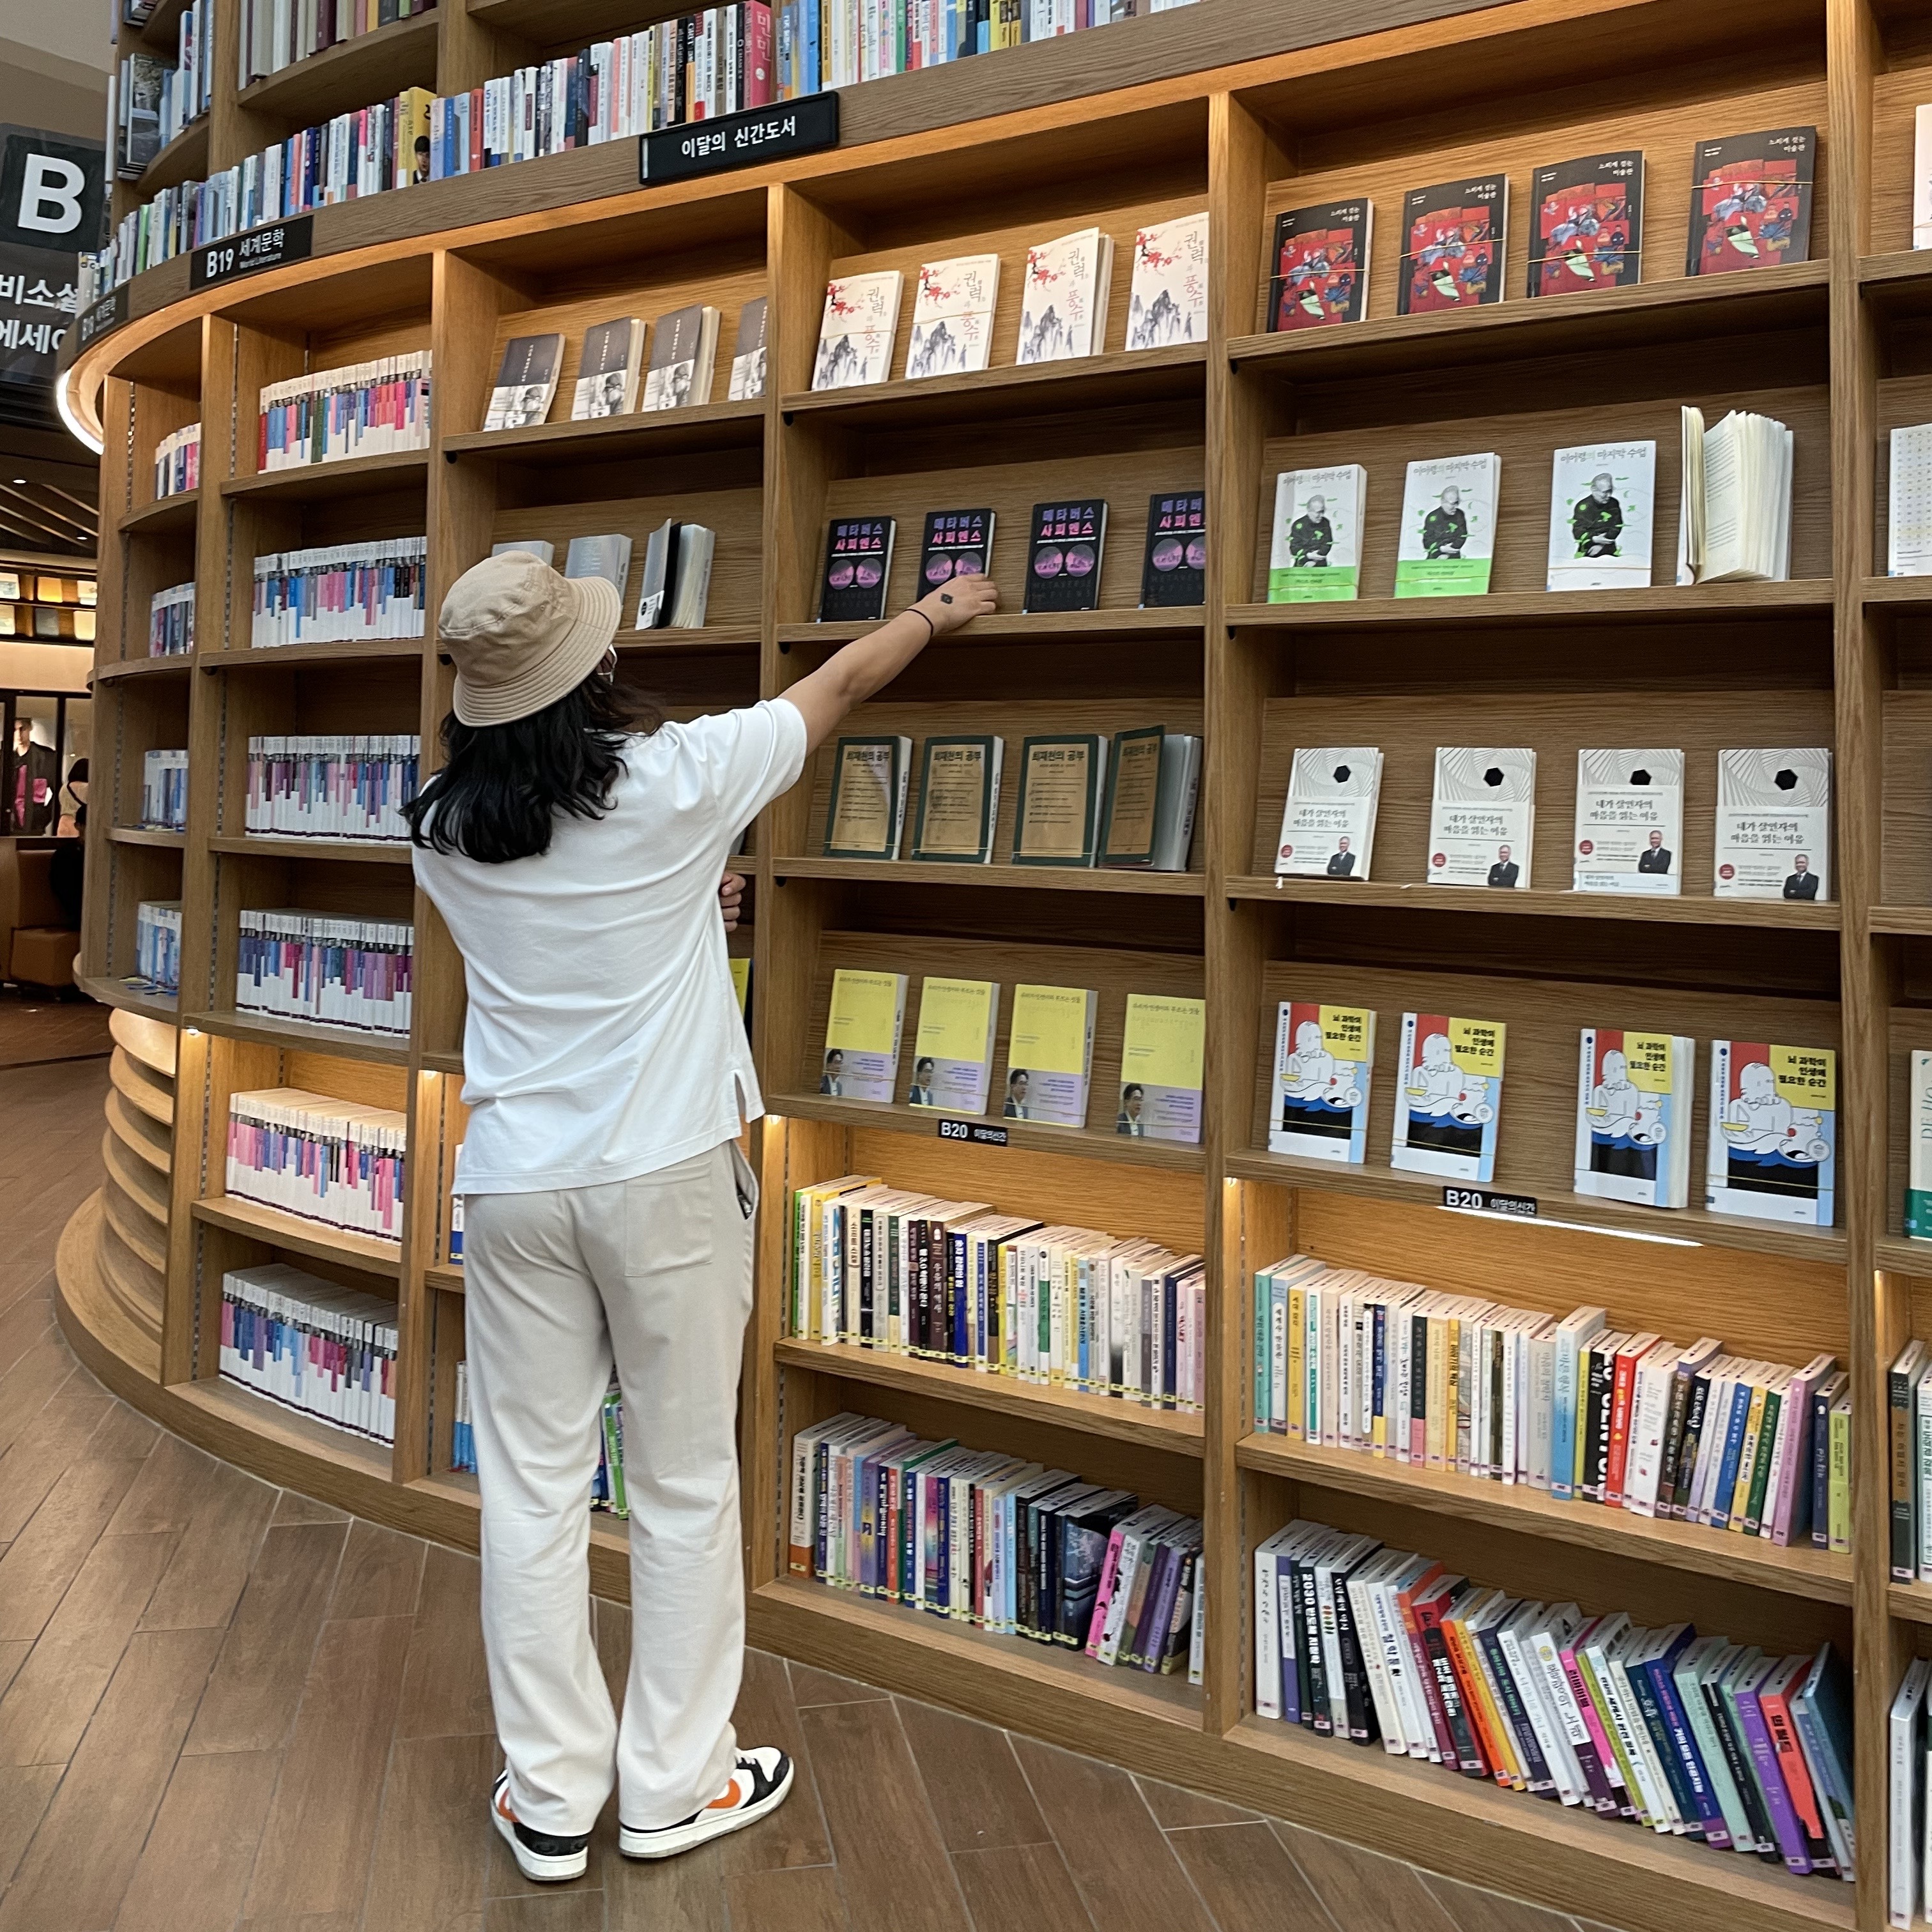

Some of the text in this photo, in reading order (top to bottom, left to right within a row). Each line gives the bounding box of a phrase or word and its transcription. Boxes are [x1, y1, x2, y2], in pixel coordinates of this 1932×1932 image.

[682, 116, 795, 158] 이달의 신간도서
[17, 153, 86, 234] B
[238, 228, 285, 257] 세계문학
[206, 248, 234, 278] B19
[1598, 448, 1626, 459] 마지막
[1627, 447, 1646, 458] 수업
[1161, 498, 1203, 513] 메타버
[1041, 521, 1094, 537] 사피엔스
[1159, 513, 1206, 529] 사피엔
[835, 537, 882, 551] 사피엔스
[932, 530, 982, 544] 사피엔스
[1068, 750, 1084, 761] 공부
[941, 1122, 968, 1138] B20
[1446, 1190, 1482, 1209] B20
